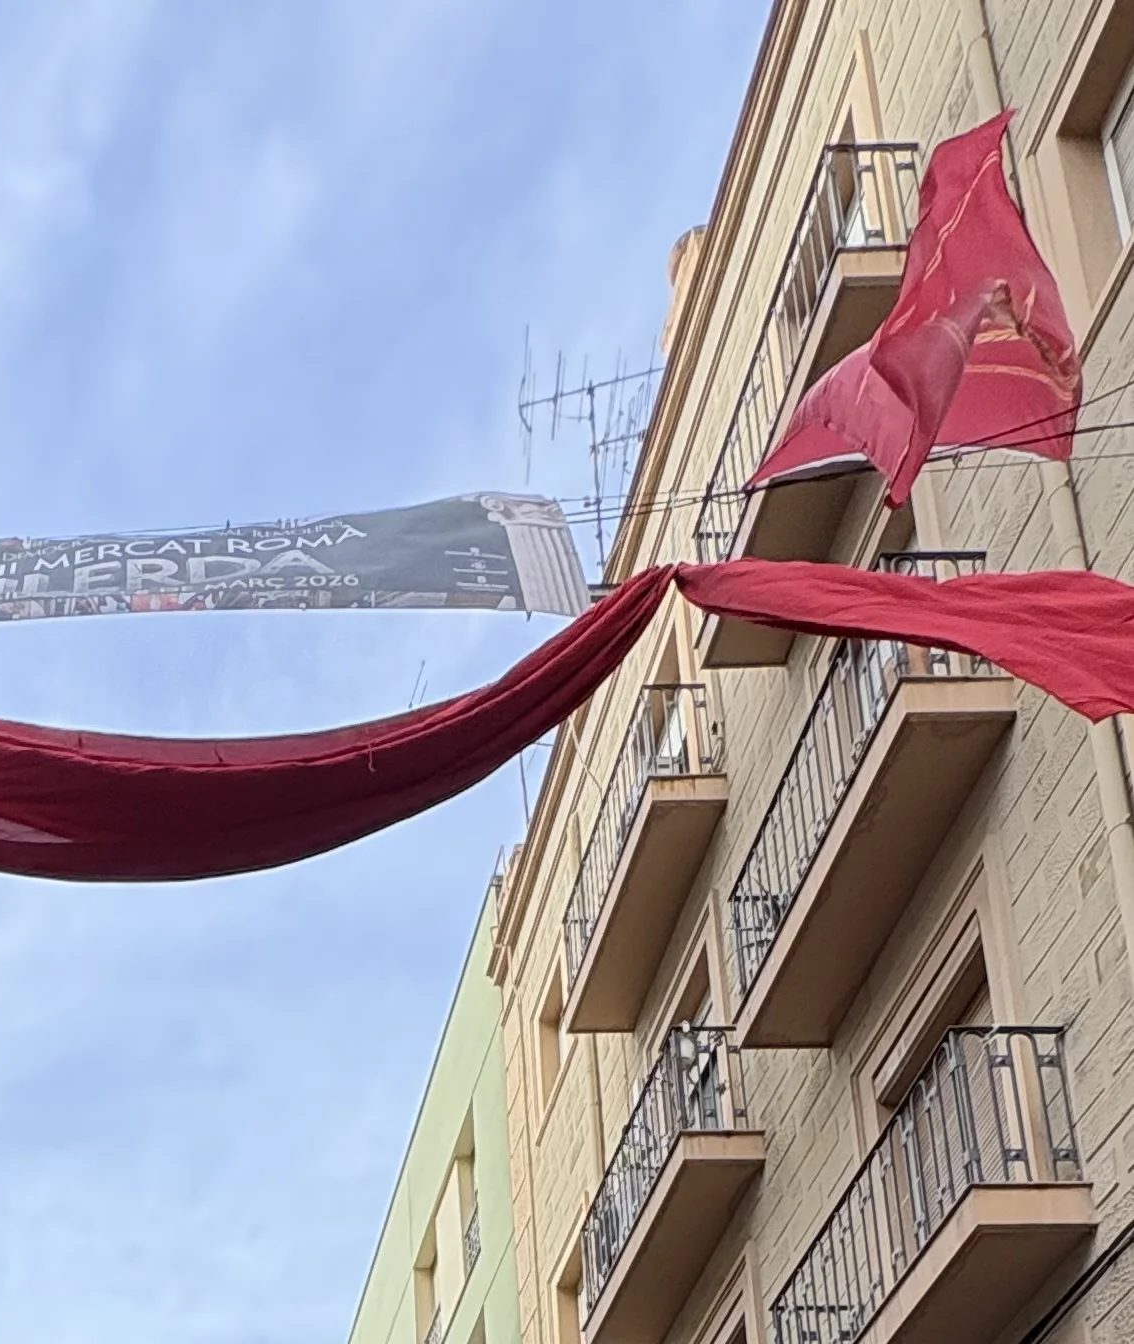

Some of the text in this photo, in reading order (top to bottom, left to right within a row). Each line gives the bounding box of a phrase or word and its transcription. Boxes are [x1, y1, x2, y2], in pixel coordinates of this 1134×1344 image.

[33, 539, 212, 572] MERCAT
[227, 524, 368, 553] ROMA
[293, 573, 360, 588] 2026
